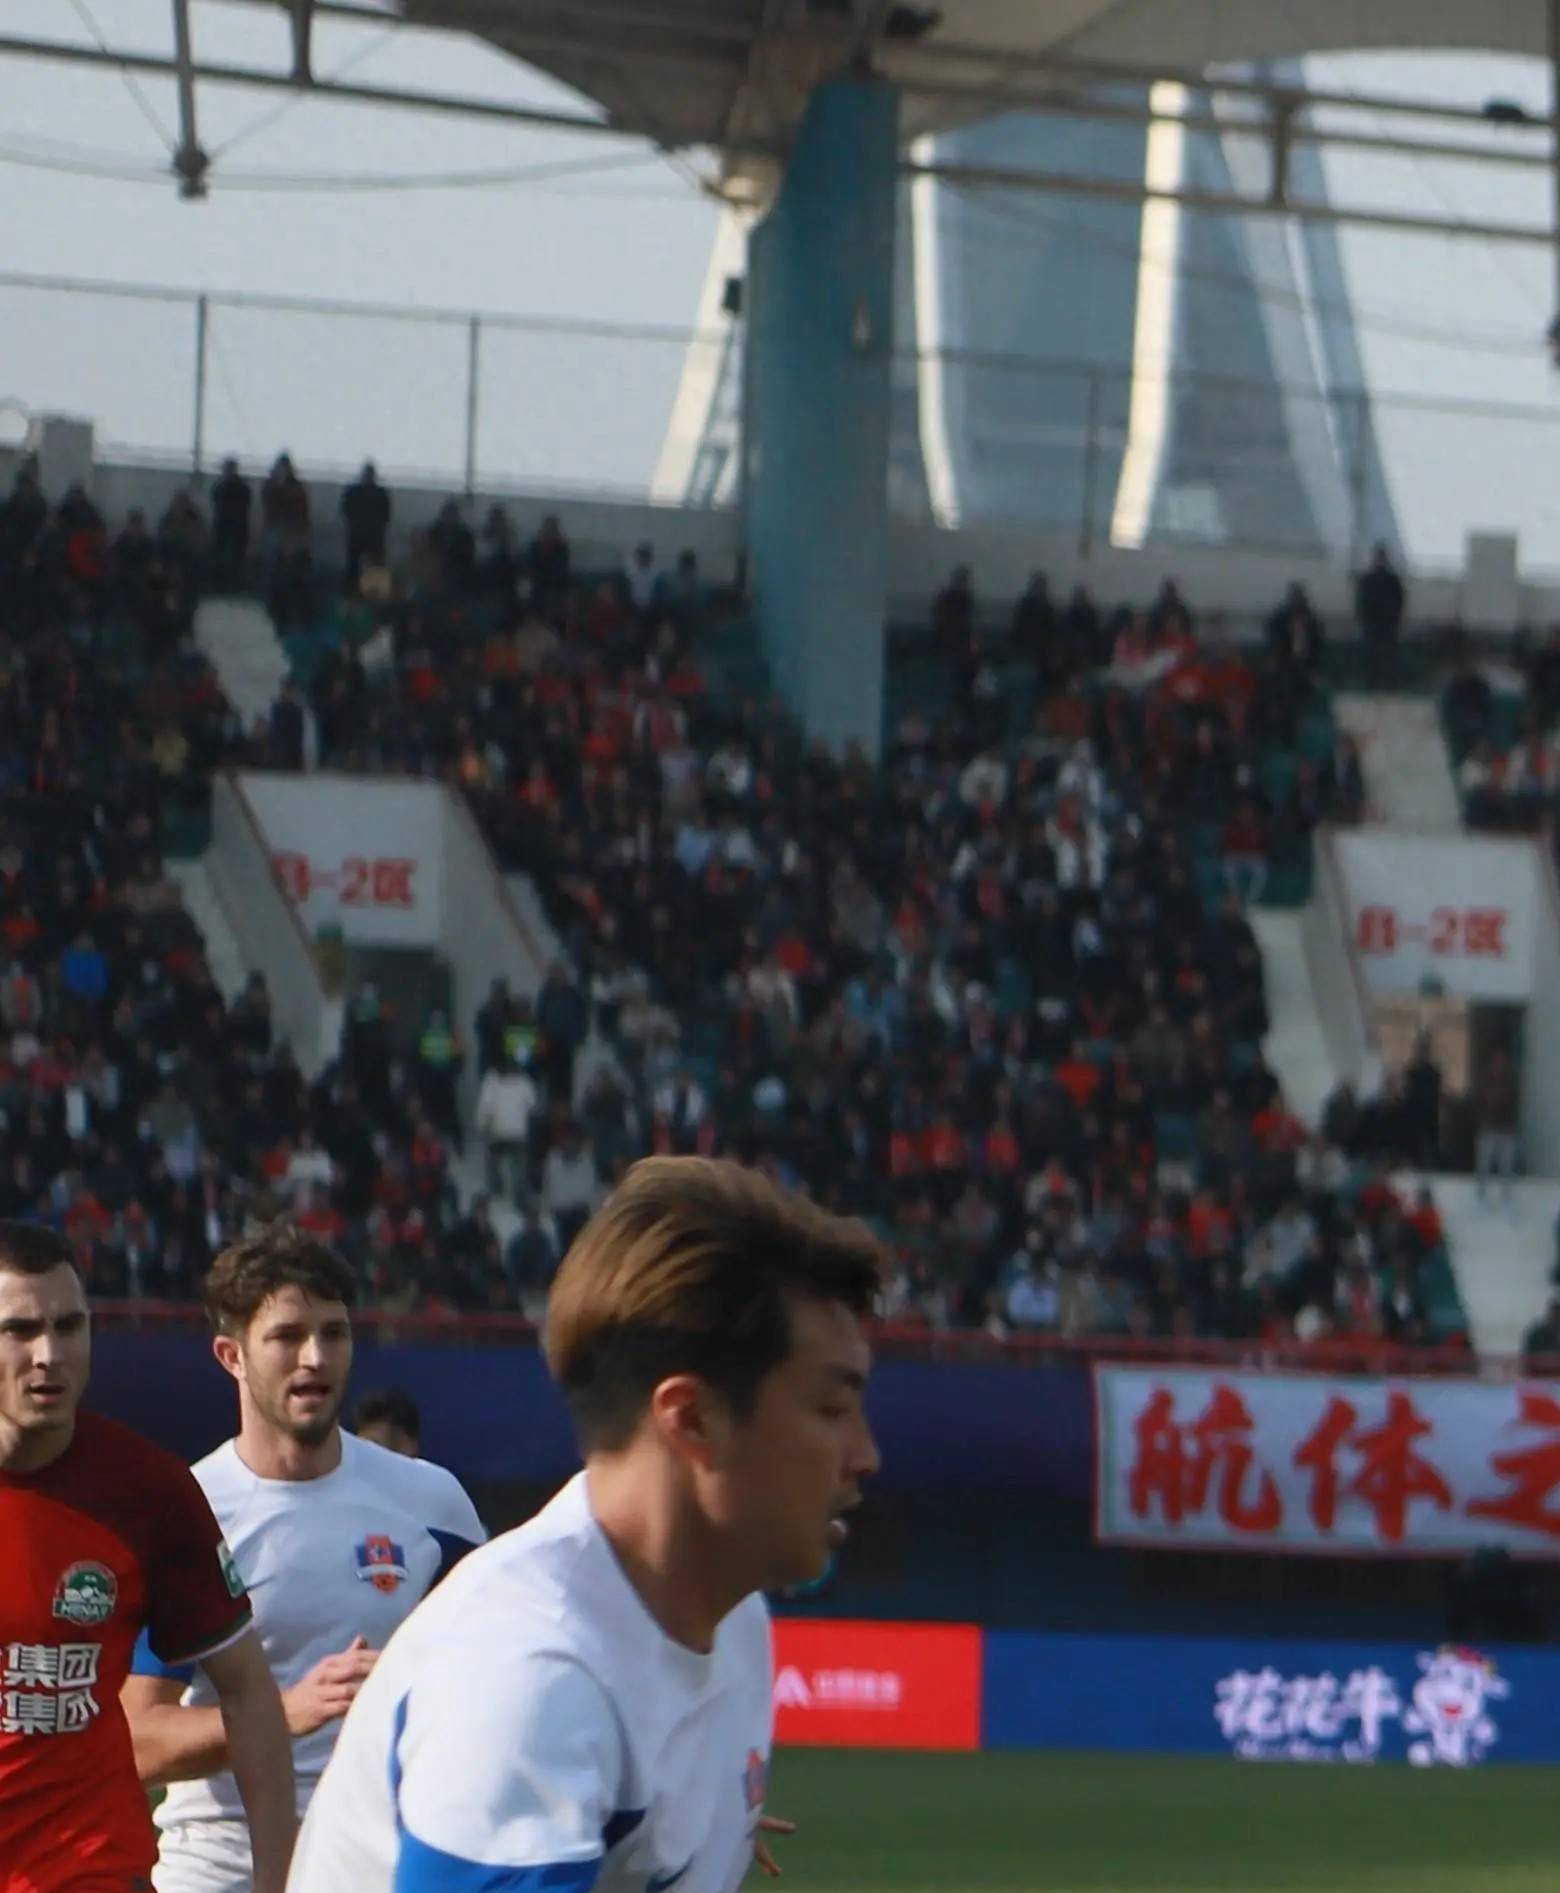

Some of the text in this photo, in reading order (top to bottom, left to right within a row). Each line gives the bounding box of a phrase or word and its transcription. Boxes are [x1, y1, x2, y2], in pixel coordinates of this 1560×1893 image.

[0, 1642, 102, 1690] 集团
[0, 1688, 100, 1735] 集团
[1212, 1665, 1399, 1744] 花花牛
